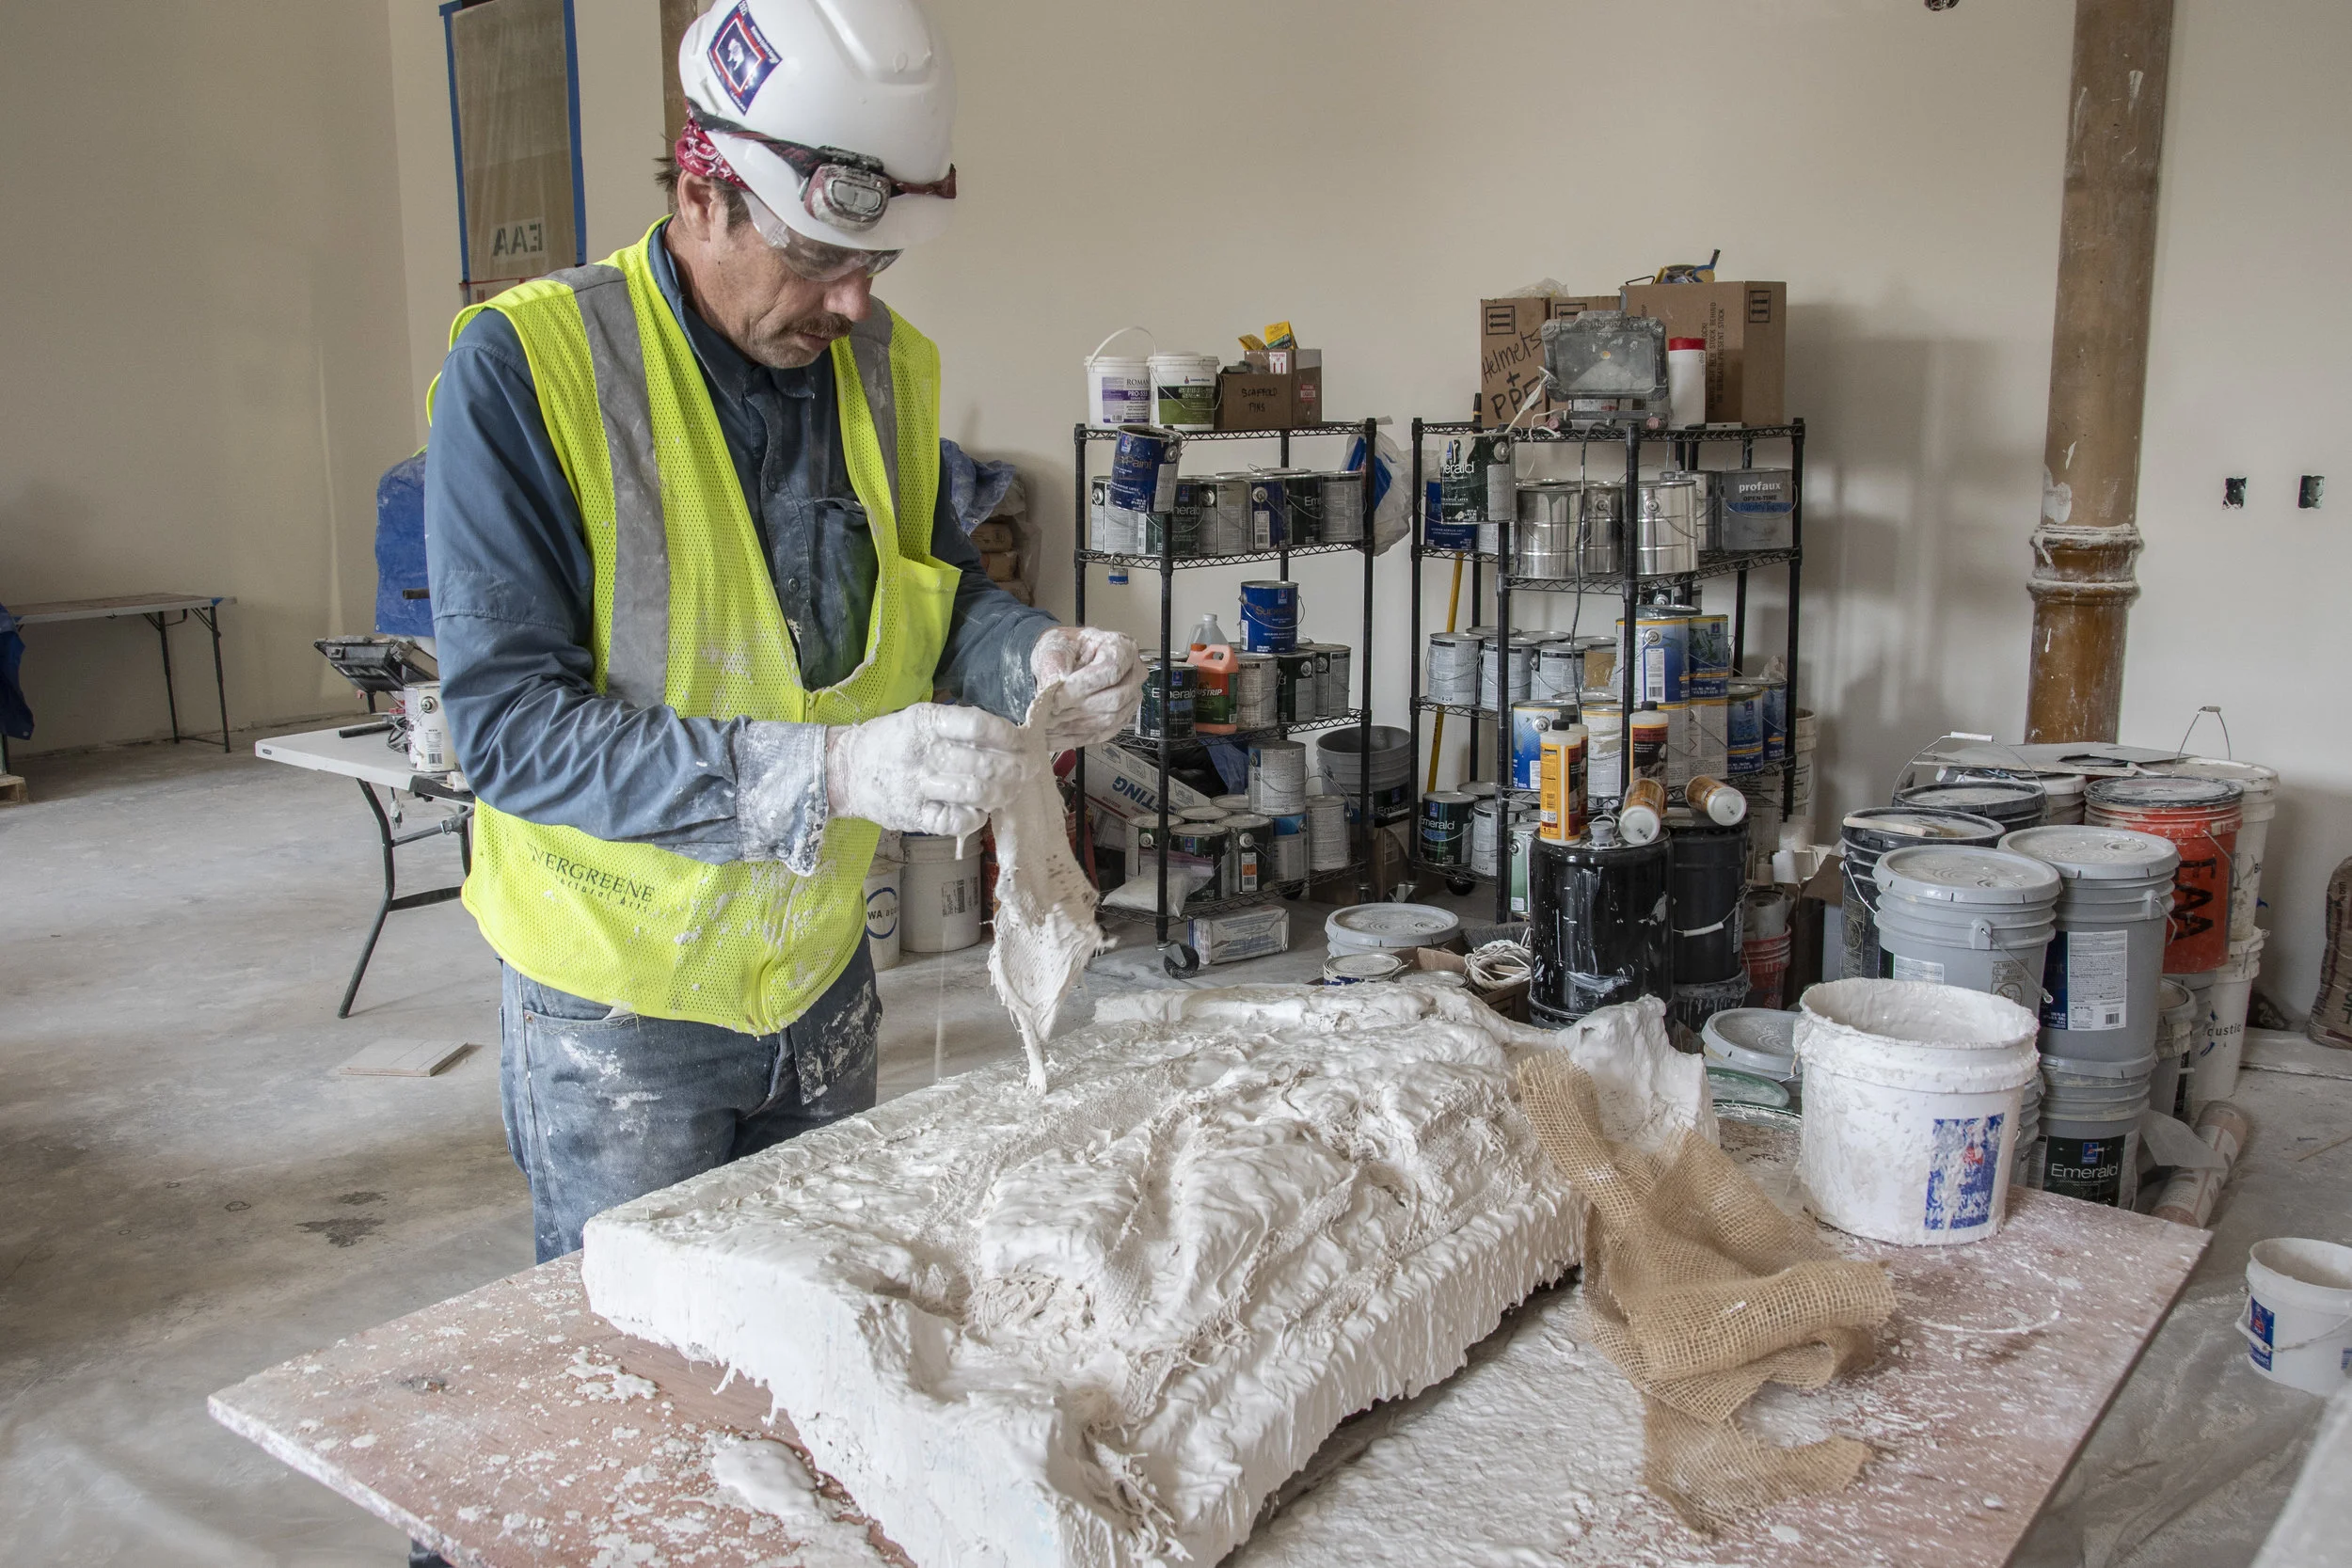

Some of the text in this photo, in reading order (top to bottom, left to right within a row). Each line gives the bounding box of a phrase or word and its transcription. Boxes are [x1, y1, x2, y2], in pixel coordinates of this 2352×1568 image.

[1490, 376, 1543, 420] PPE
[1739, 481, 1781, 494] profaux
[1152, 688, 1196, 700] Eerald
[2051, 1162, 2119, 1179] Emerald
